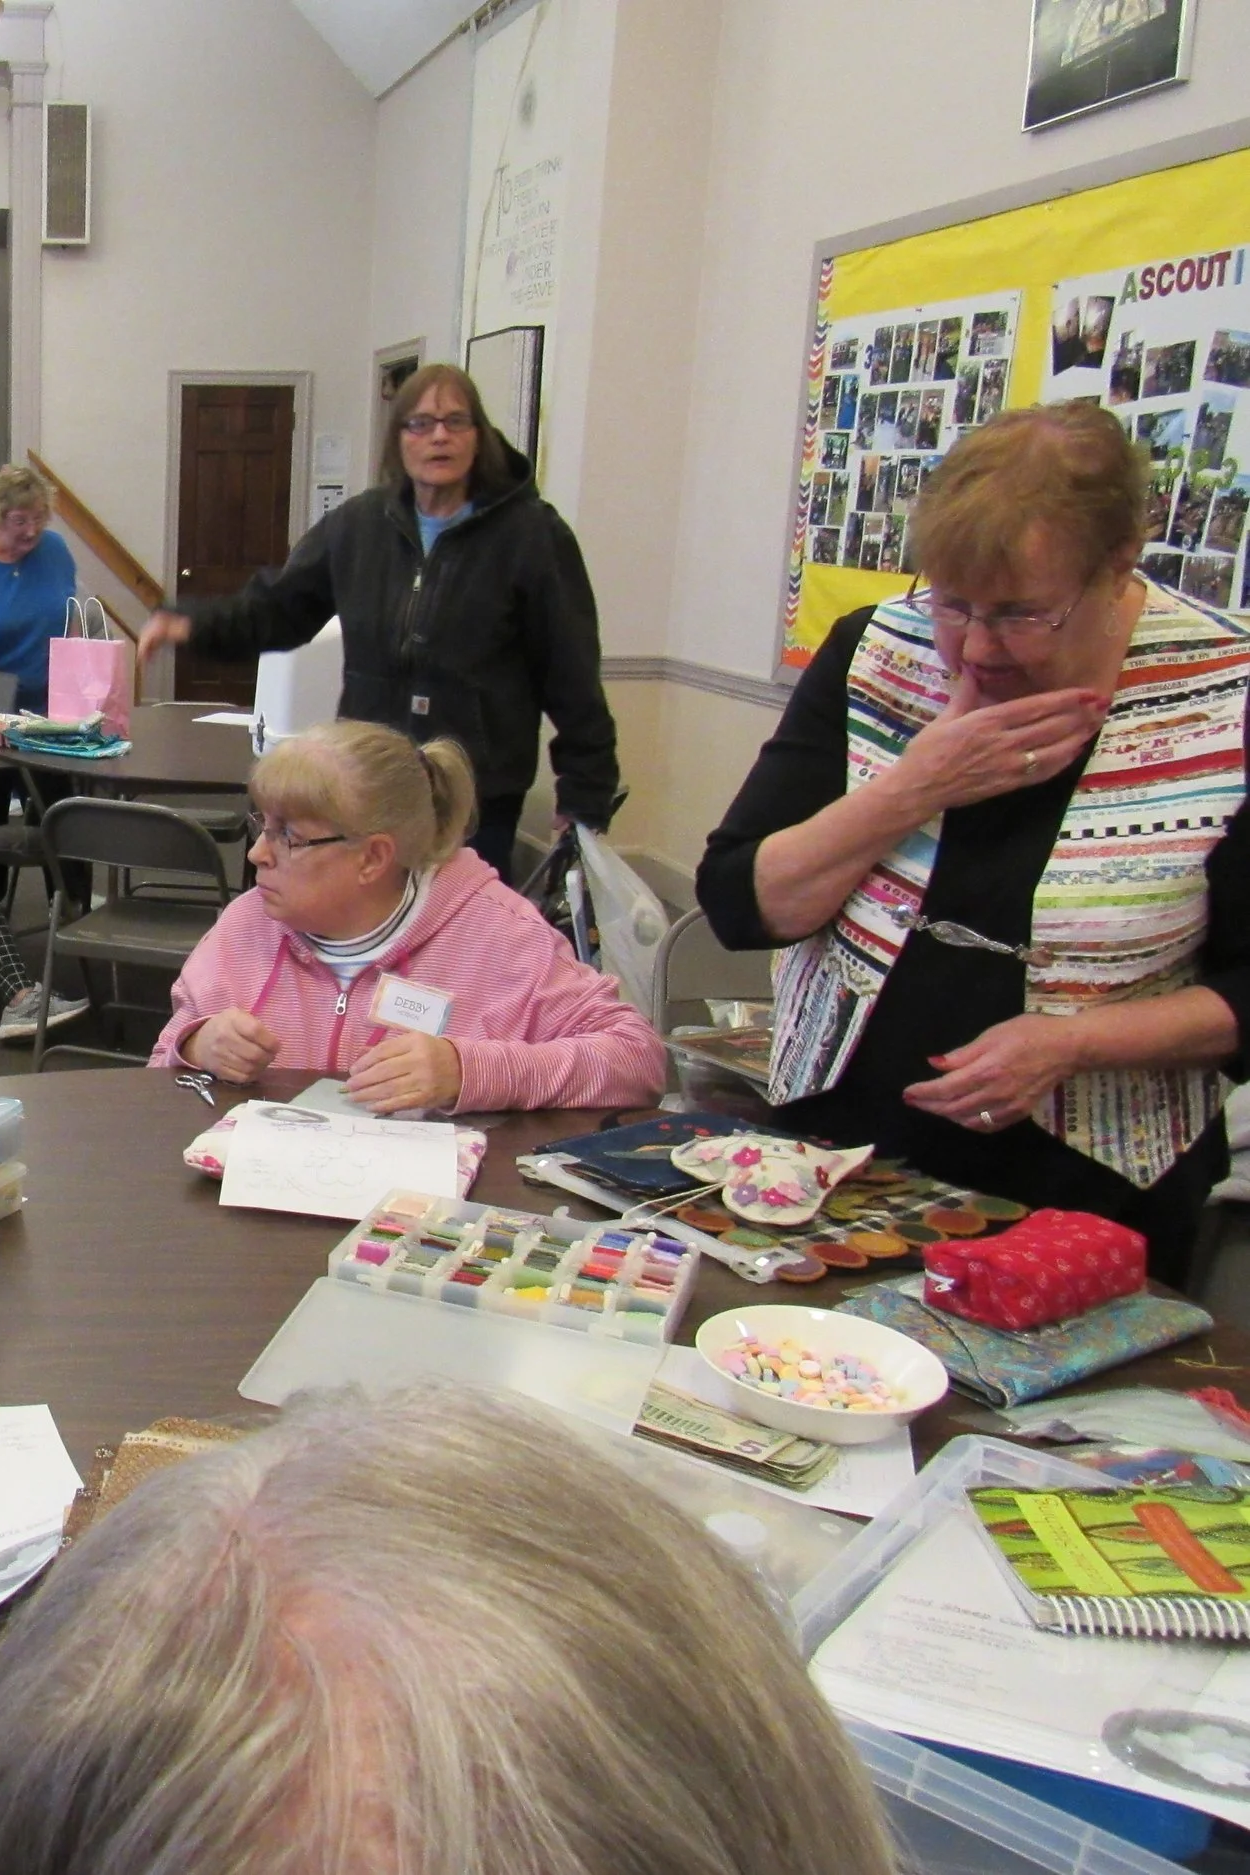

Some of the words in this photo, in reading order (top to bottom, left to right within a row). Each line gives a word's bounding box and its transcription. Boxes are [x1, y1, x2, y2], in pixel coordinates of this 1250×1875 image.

[1118, 271, 1138, 305] A
[1139, 250, 1232, 300] SCOUT
[394, 995, 431, 1016] DEBBY
[733, 1439, 770, 1455] 5
